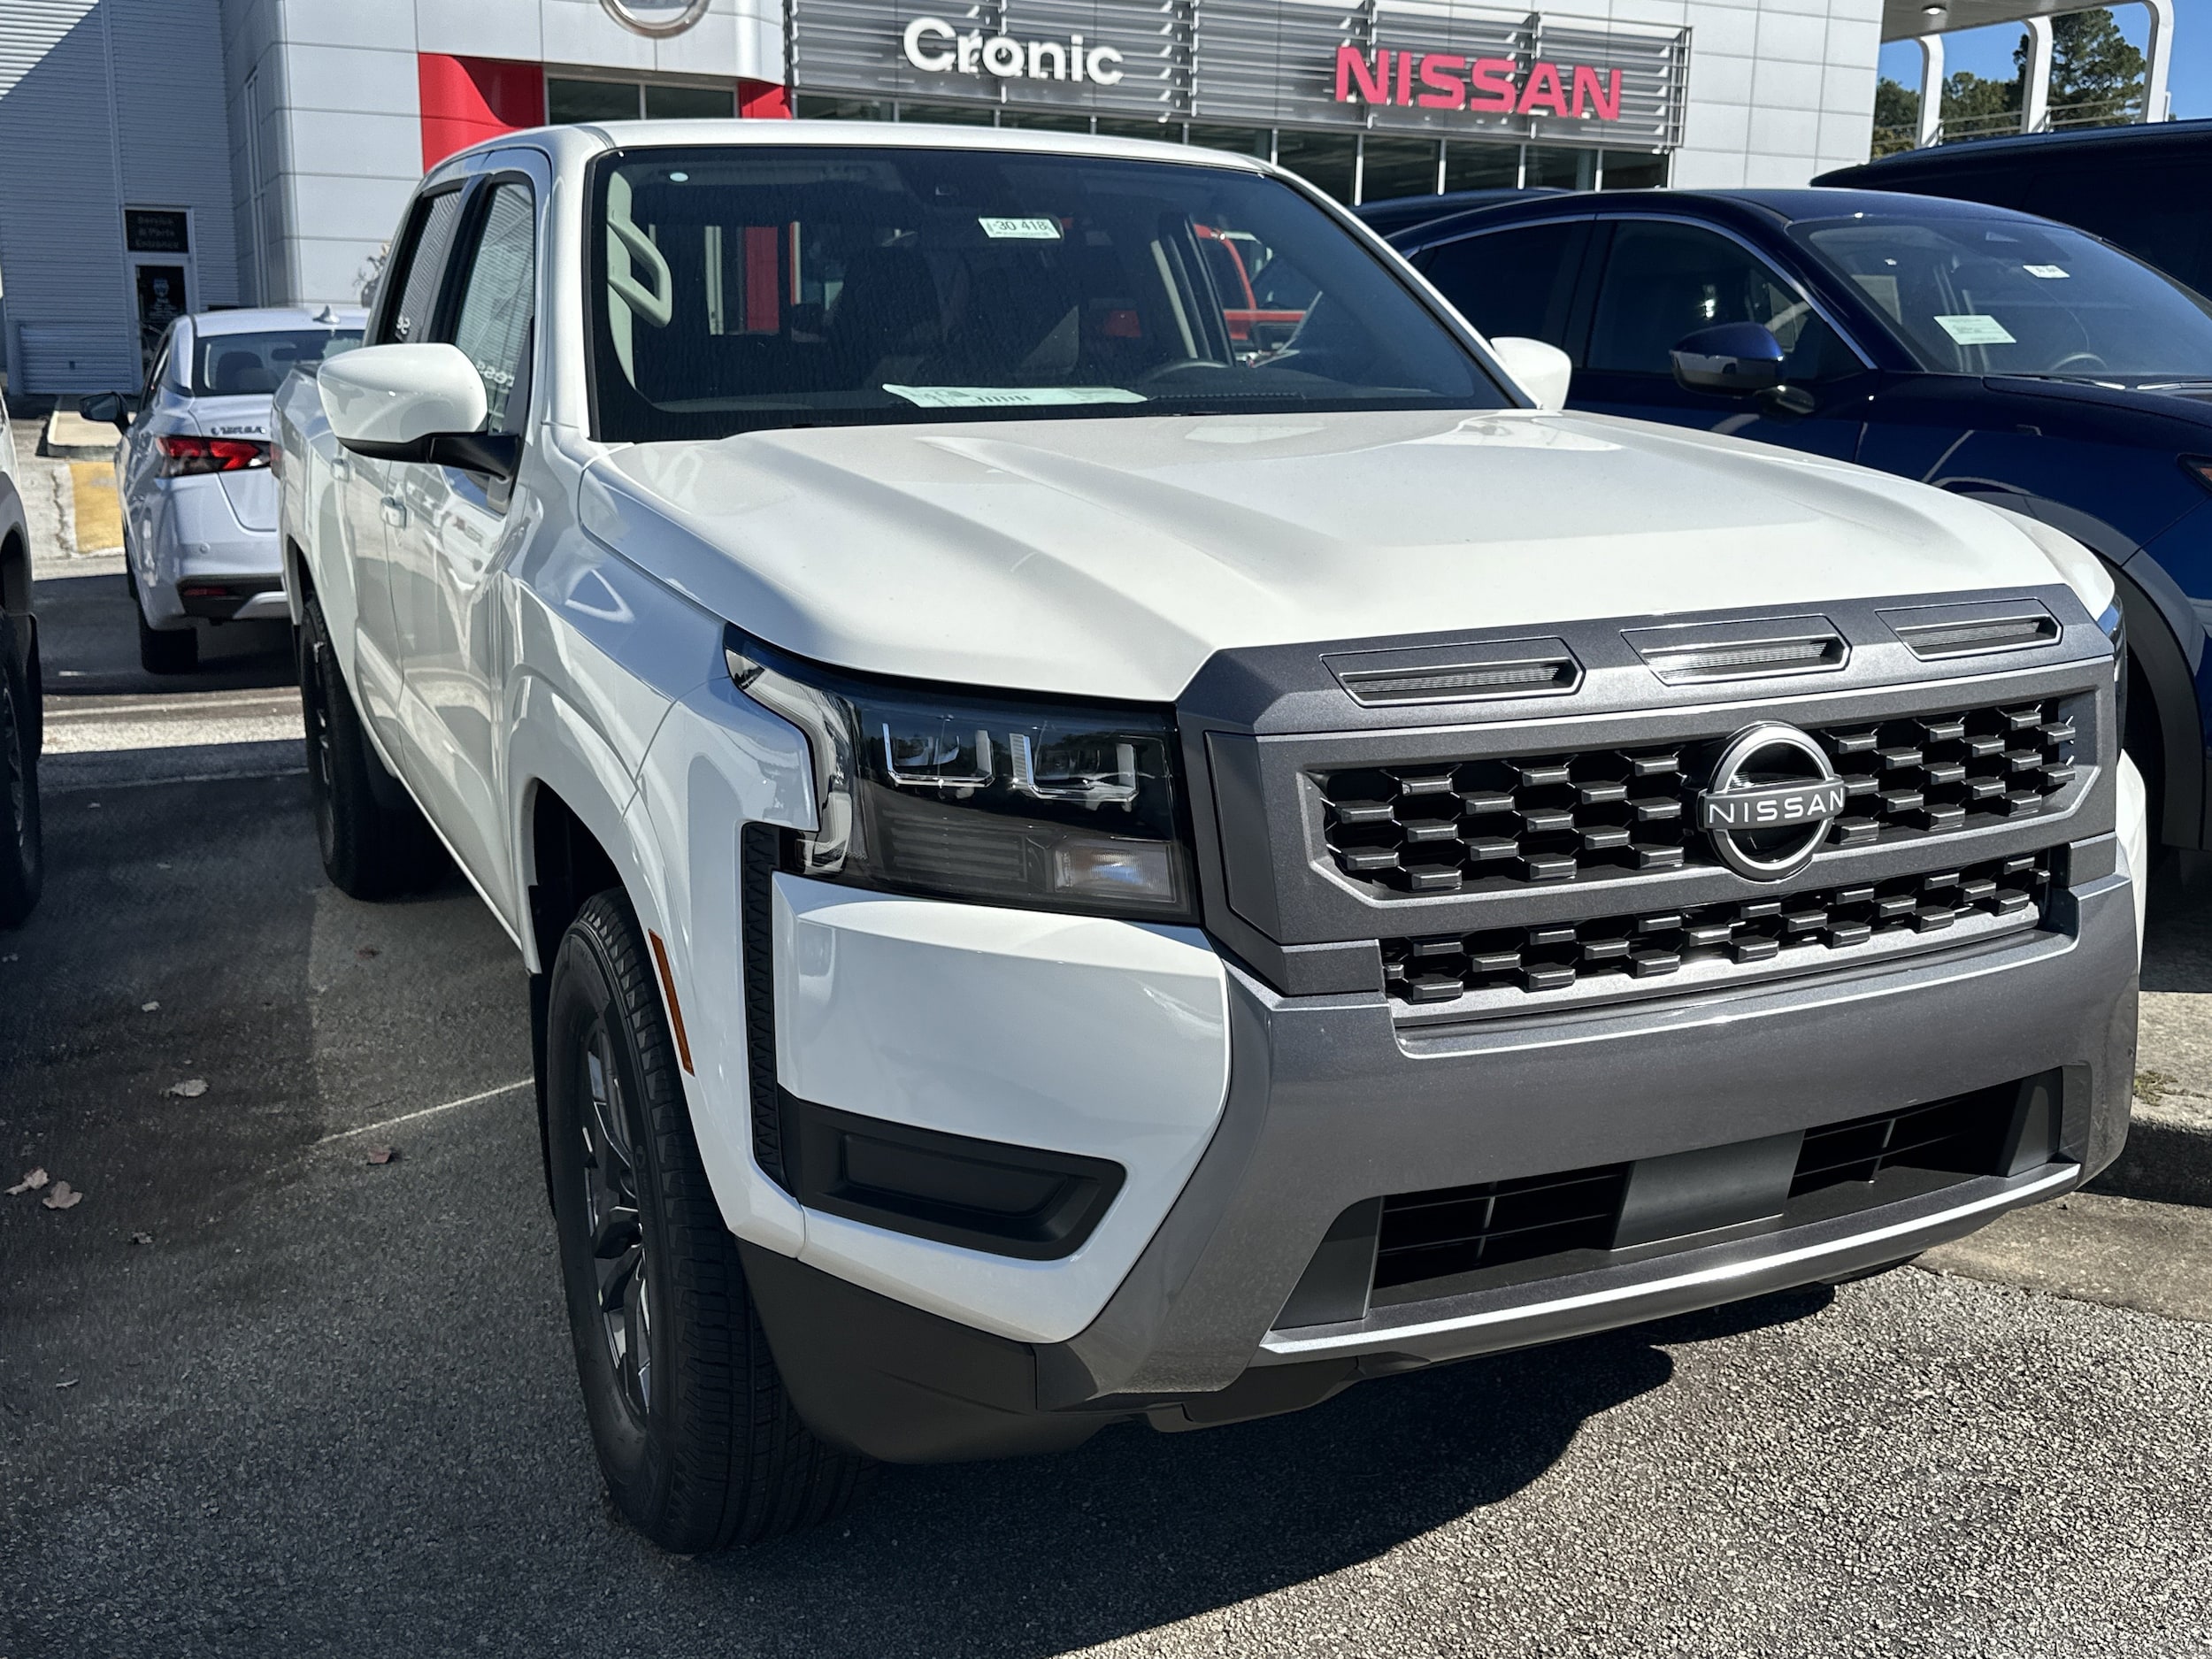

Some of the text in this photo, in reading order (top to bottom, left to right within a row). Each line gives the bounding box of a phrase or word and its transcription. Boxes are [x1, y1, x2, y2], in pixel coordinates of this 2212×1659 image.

[903, 17, 1124, 85] Cronic
[1335, 46, 1622, 120] NISSAN
[1709, 787, 1844, 824] NISSAN
